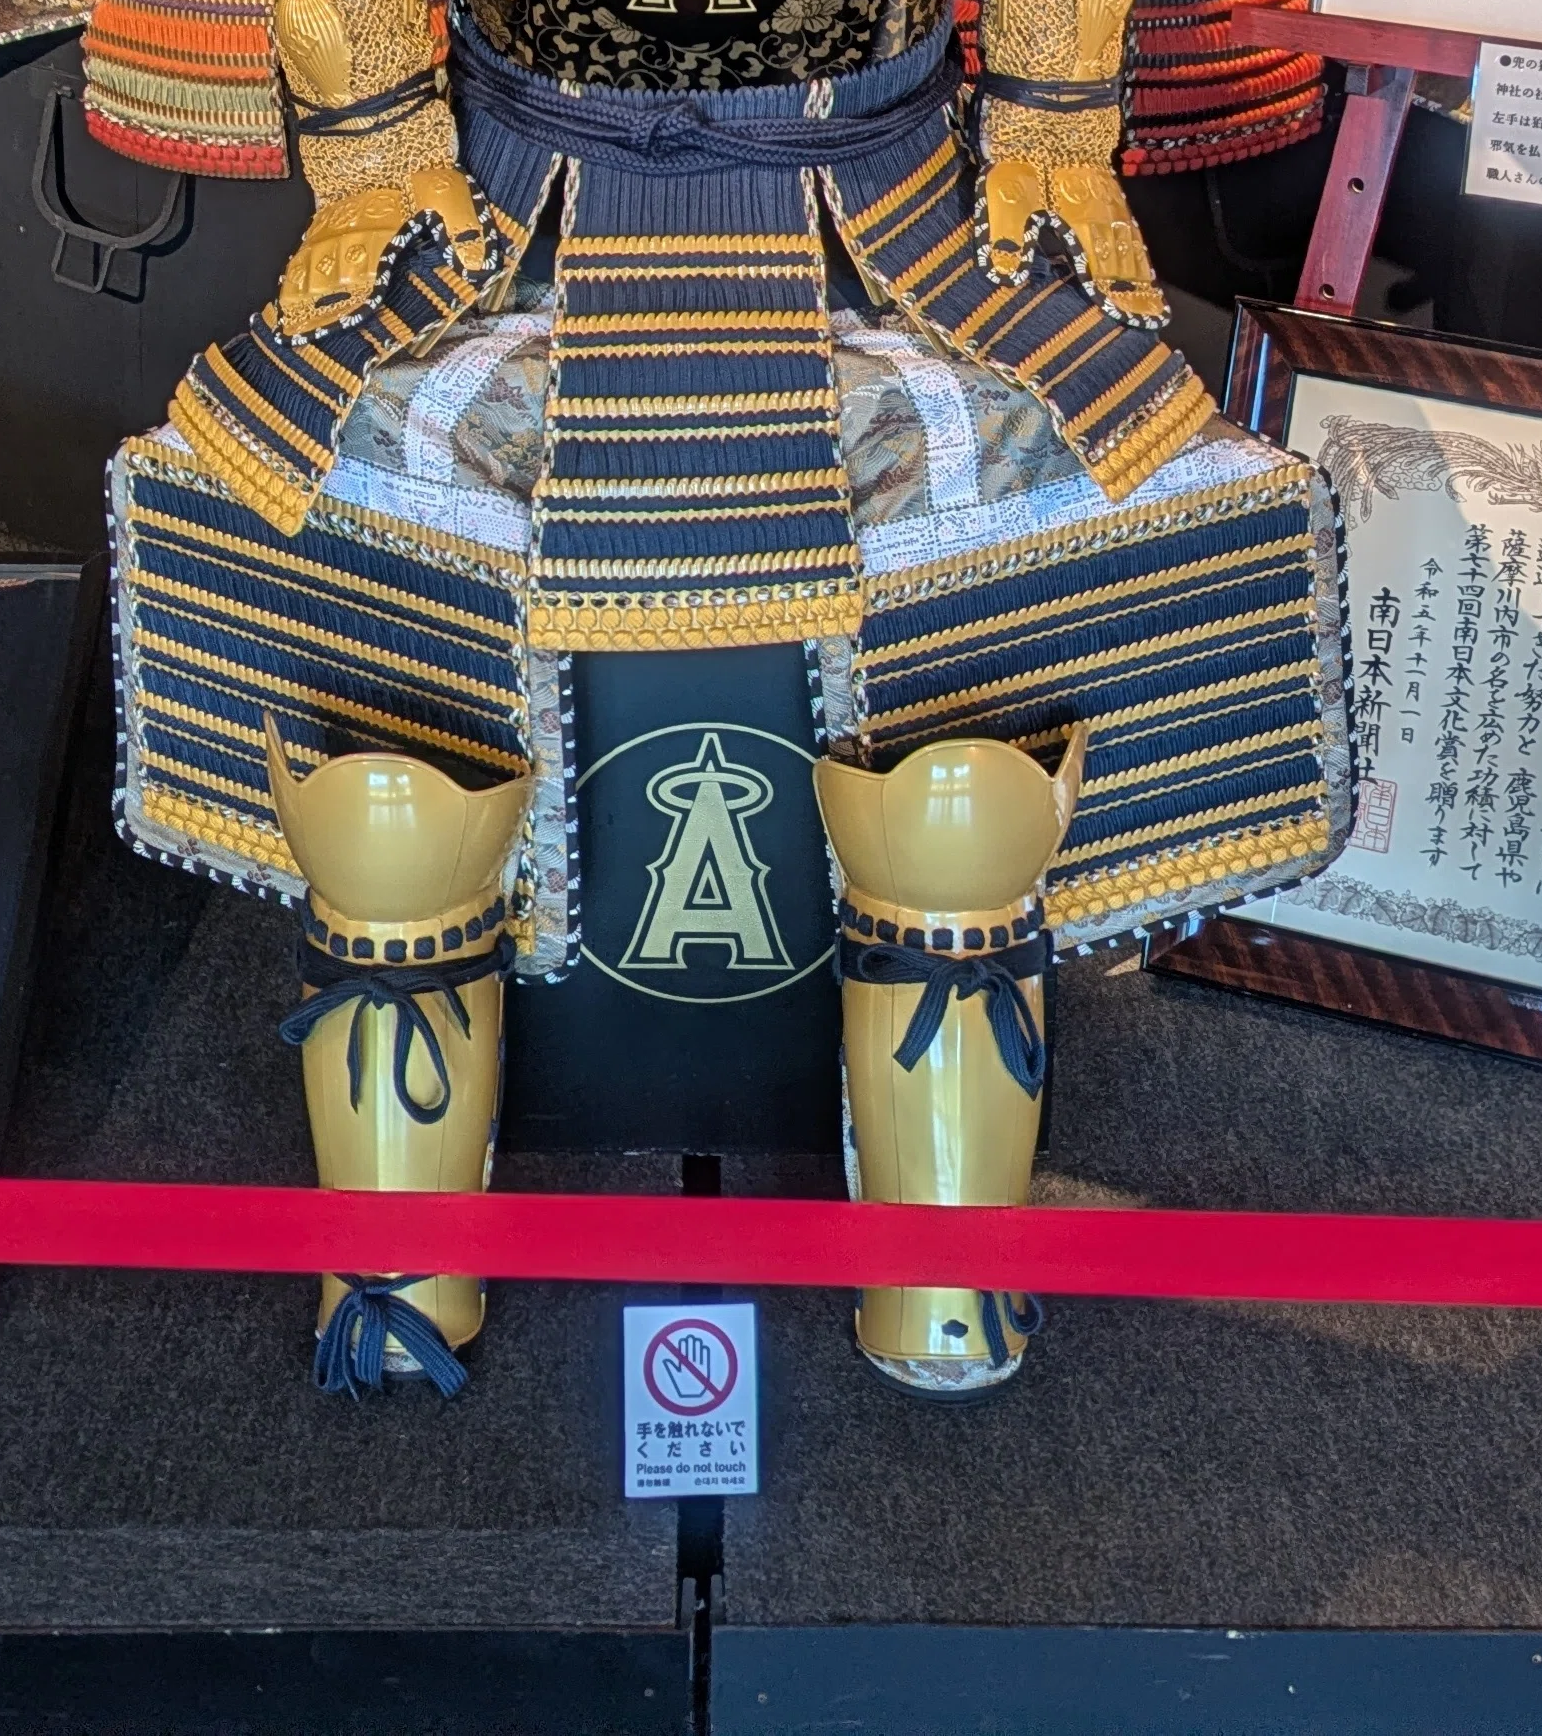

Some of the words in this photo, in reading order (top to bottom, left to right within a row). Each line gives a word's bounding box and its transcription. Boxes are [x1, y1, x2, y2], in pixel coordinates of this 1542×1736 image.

[1398, 557, 1443, 745] 令和五年十一月一日
[1420, 523, 1494, 868] 第七十四回南日本文化賞を贈ります
[1460, 528, 1531, 882] 薩摩川内市の名を広めた功績に対して
[617, 732, 795, 970] A
[636, 1420, 745, 1440] 手を触れないで
[636, 1463, 673, 1475] Please
[675, 1462, 690, 1474] do
[693, 1462, 712, 1473] not
[714, 1461, 746, 1473] touch
[637, 1440, 746, 1459] ください
